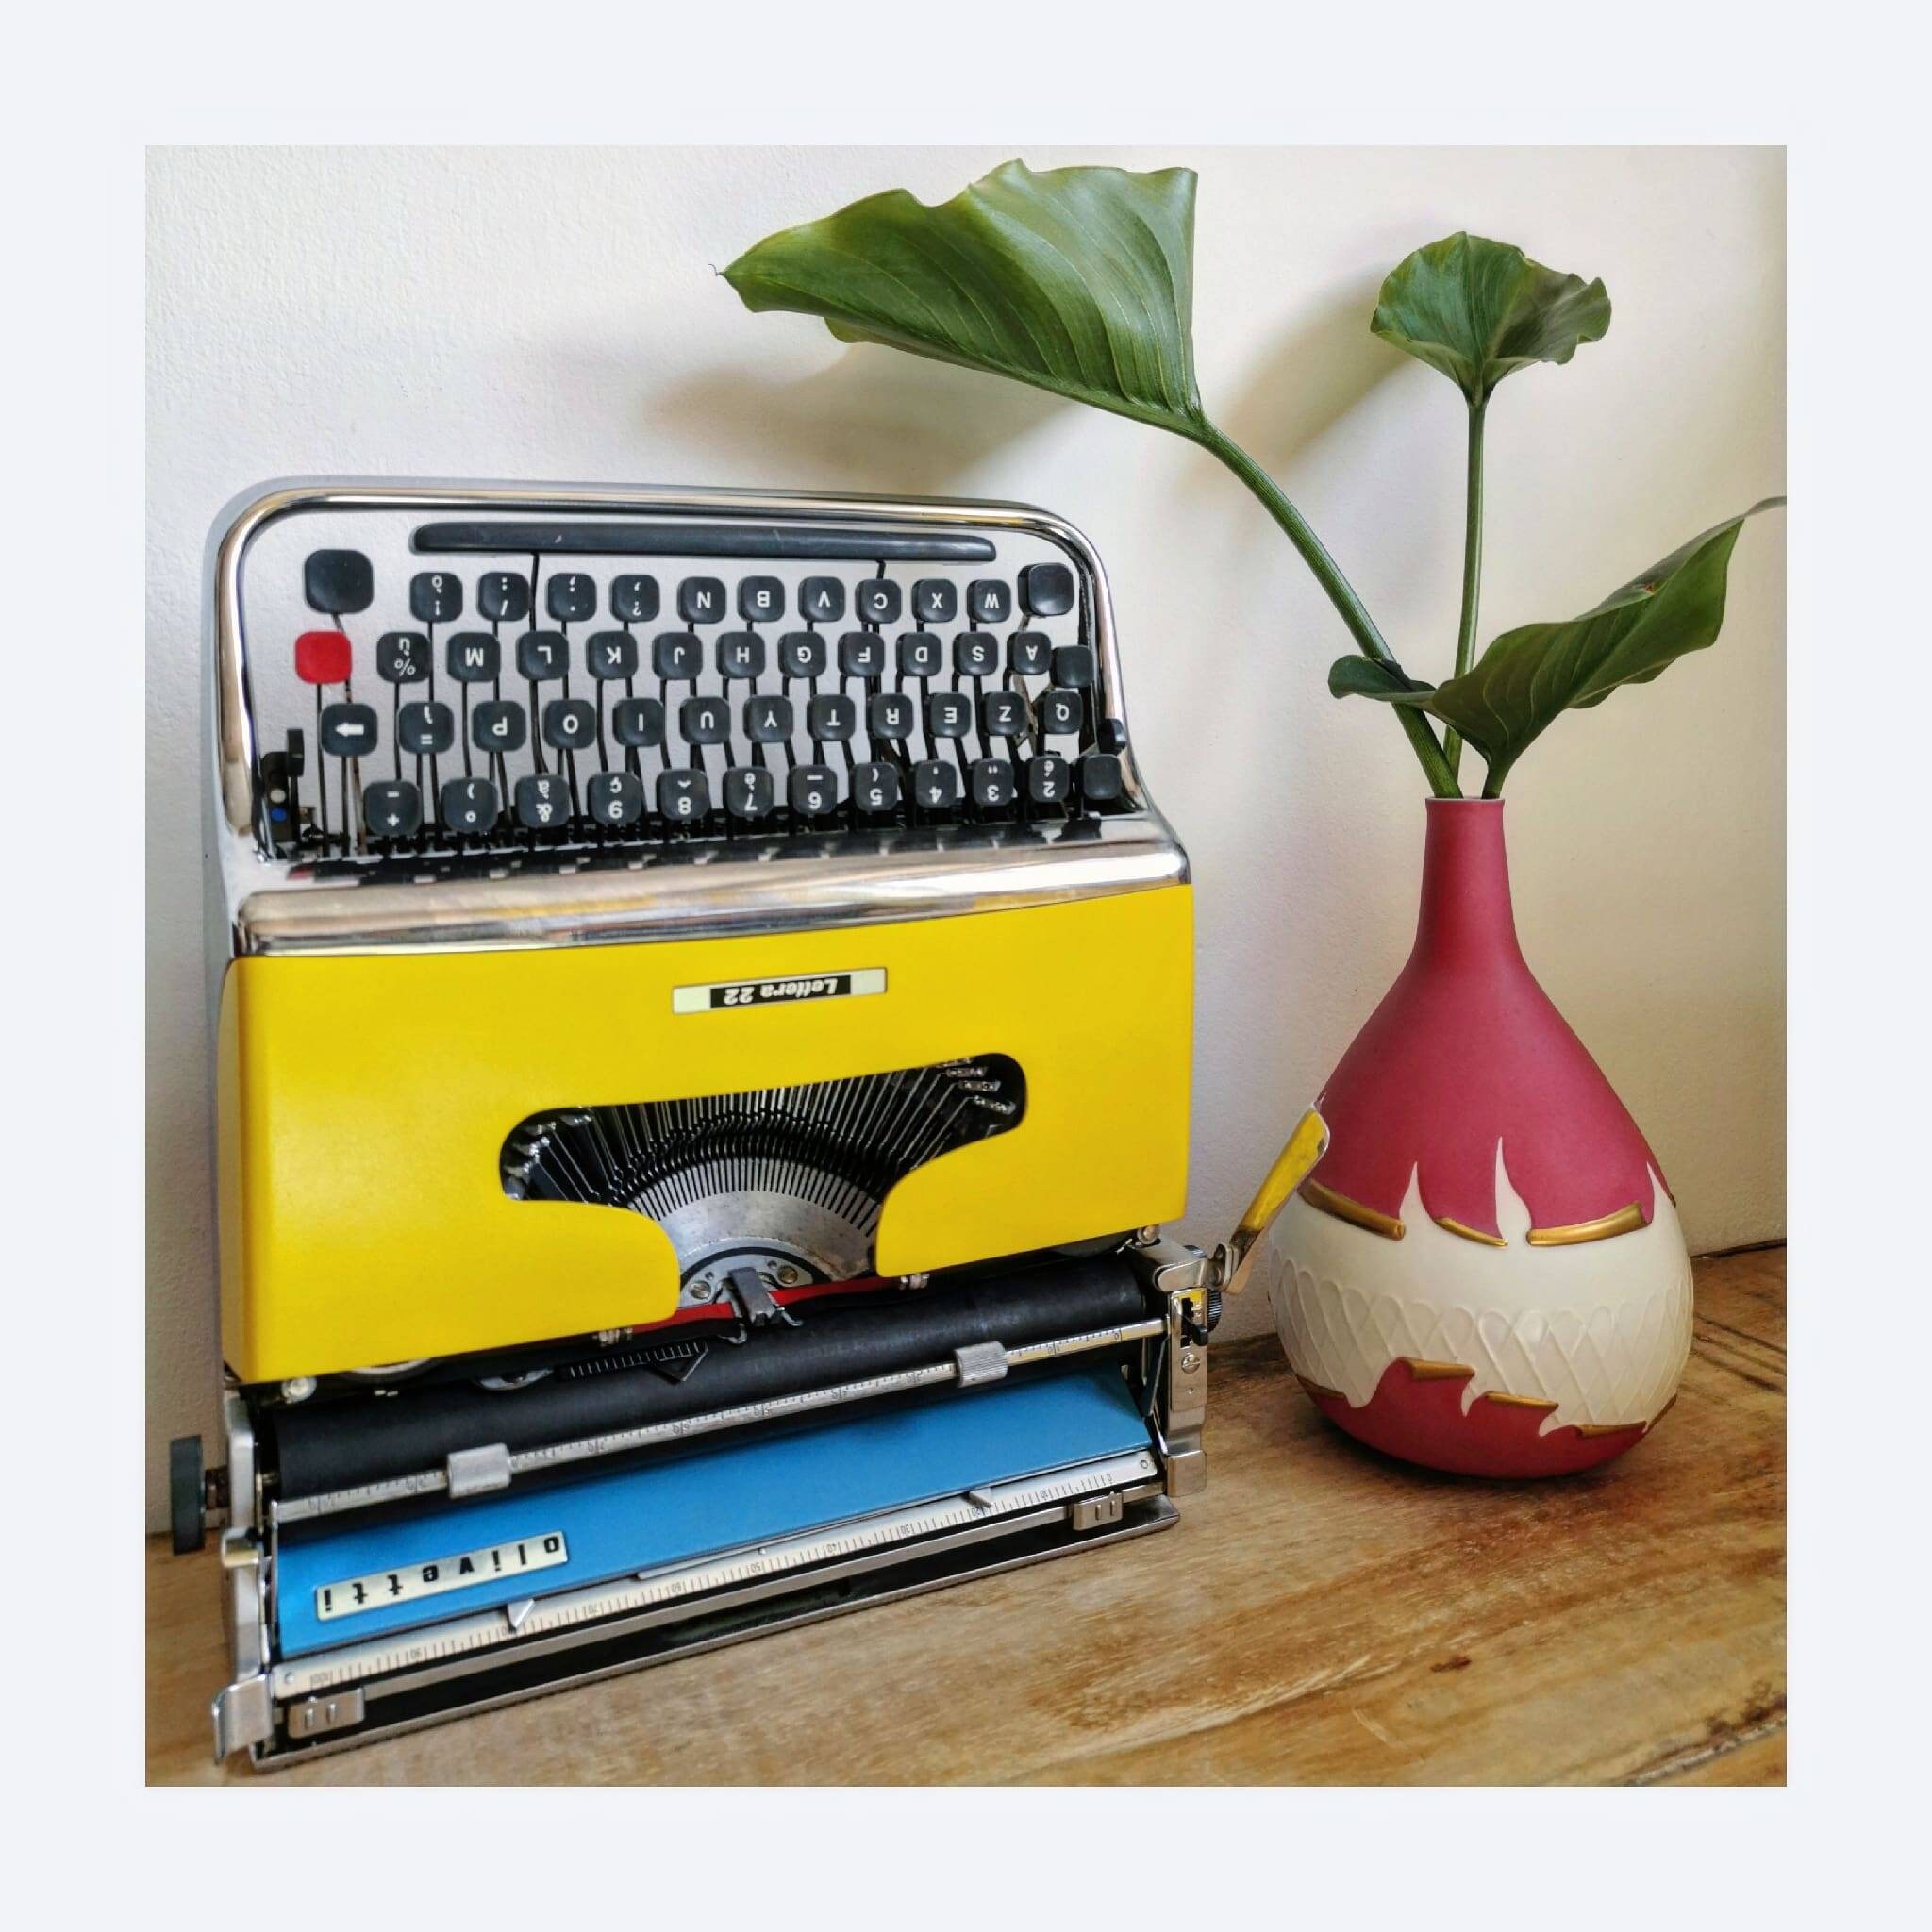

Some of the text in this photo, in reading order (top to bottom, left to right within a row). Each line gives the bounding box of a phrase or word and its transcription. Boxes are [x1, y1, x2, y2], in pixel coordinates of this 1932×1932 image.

[696, 591, 711, 609] N
[757, 590, 771, 608] B
[817, 591, 831, 608] V
[874, 592, 889, 610] C
[931, 592, 943, 609] X
[984, 593, 1000, 609] W
[465, 647, 484, 667] M
[537, 645, 552, 664] L
[606, 646, 622, 665] K
[674, 646, 685, 665] J
[736, 646, 750, 664] H
[796, 646, 812, 664] G
[857, 646, 871, 664] F
[914, 646, 928, 663] D
[972, 645, 985, 662] S
[1025, 645, 1039, 661] A
[700, 711, 715, 730] U
[763, 710, 778, 728] Y
[826, 708, 841, 726] T
[885, 708, 900, 725] R
[943, 706, 958, 724] E
[998, 705, 1012, 723] Z
[1055, 702, 1070, 722] Q
[492, 716, 508, 736] P
[562, 714, 579, 734] O
[638, 713, 644, 732] I
[869, 788, 883, 806] 5
[929, 786, 943, 804] 4
[987, 784, 1000, 802] 3
[1042, 781, 1056, 798] 2
[608, 799, 623, 819] 9
[677, 796, 692, 816] 8
[743, 792, 758, 812] 7
[808, 791, 823, 810] 6
[724, 977, 838, 1006] Lettera 22
[323, 1537, 560, 1612] olivetti
[750, 1561, 760, 1572] 50
